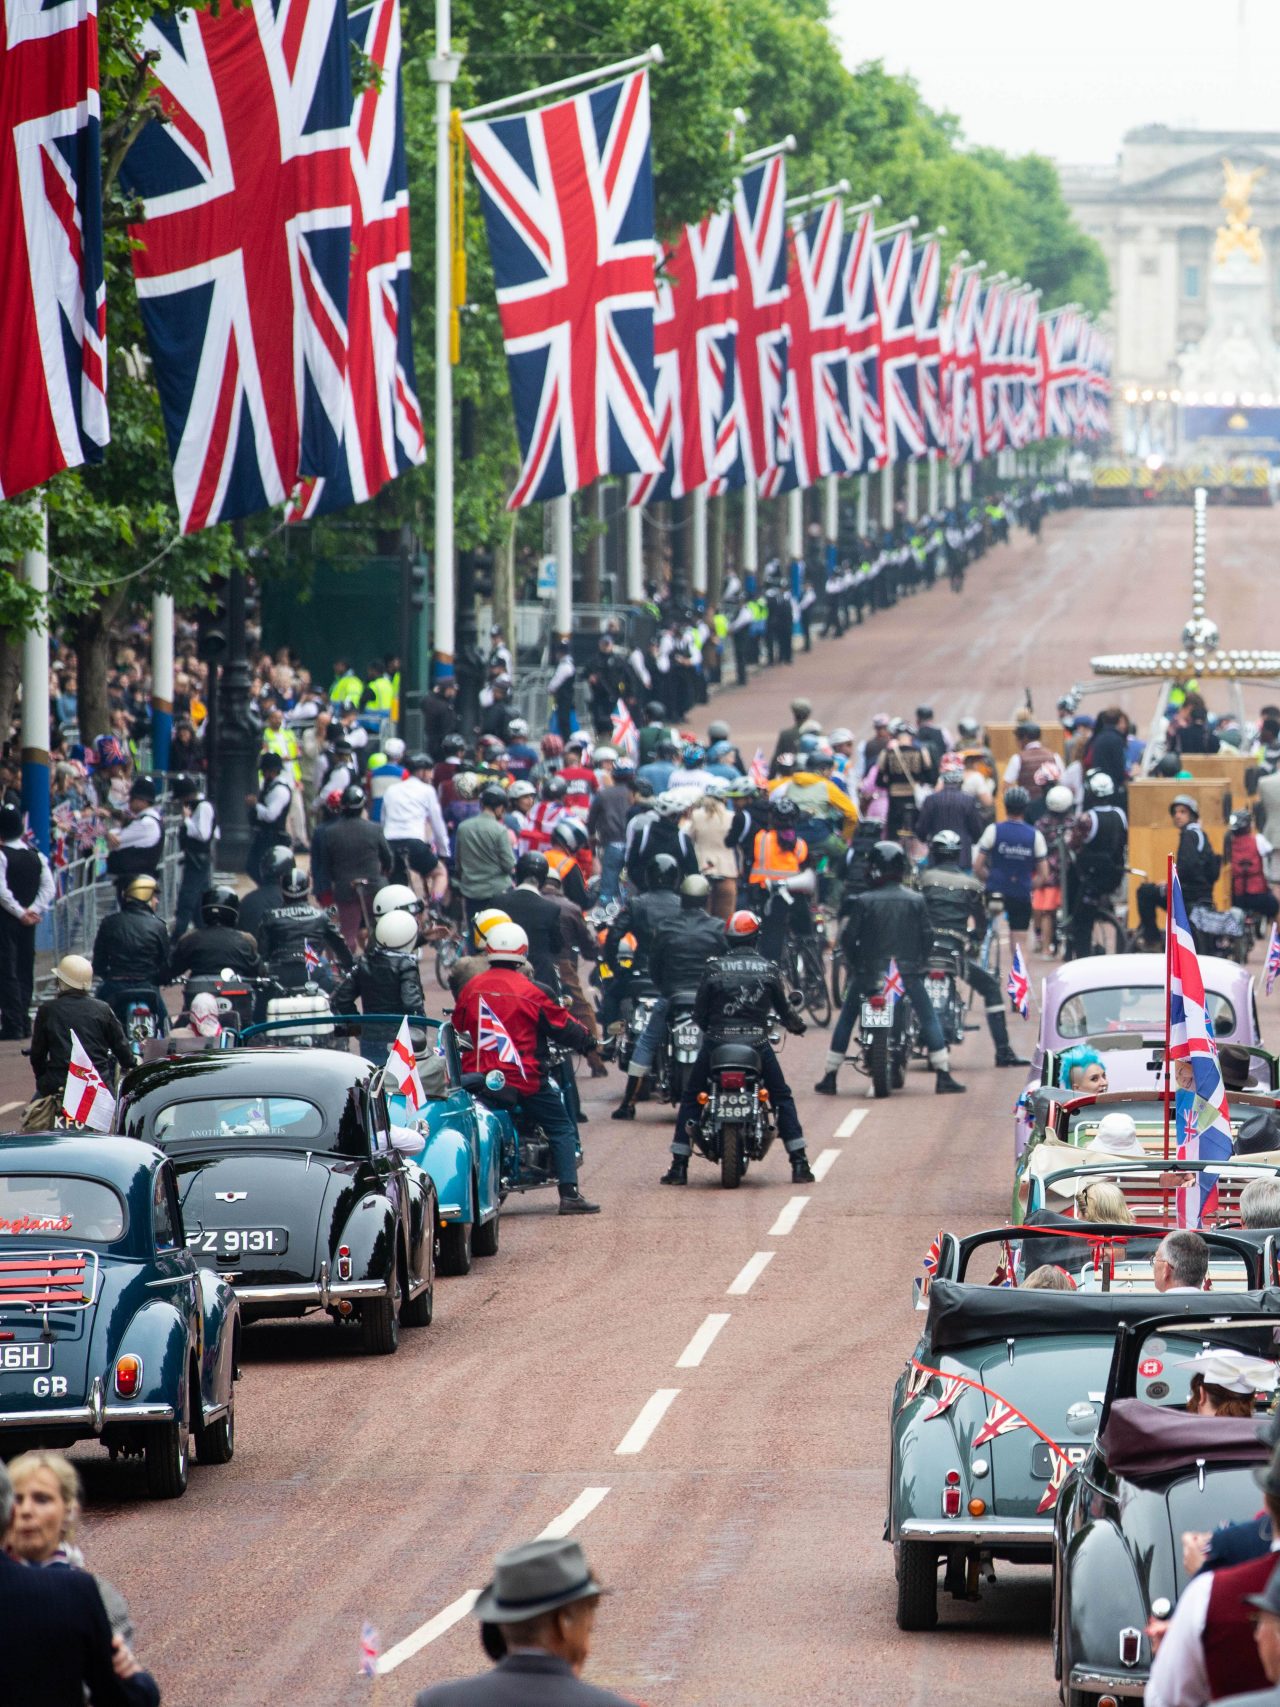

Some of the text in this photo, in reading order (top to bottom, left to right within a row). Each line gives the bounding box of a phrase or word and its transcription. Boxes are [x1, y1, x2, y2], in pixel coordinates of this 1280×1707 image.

[721, 960, 768, 972] LIVE FAST
[865, 1015, 890, 1025] XVG
[720, 1095, 748, 1105] PGC
[717, 1107, 751, 1117] 256P
[0, 1215, 73, 1235] ngland
[224, 1231, 273, 1251] 9131
[0, 1346, 39, 1367] 6H
[33, 1376, 68, 1397] GB
